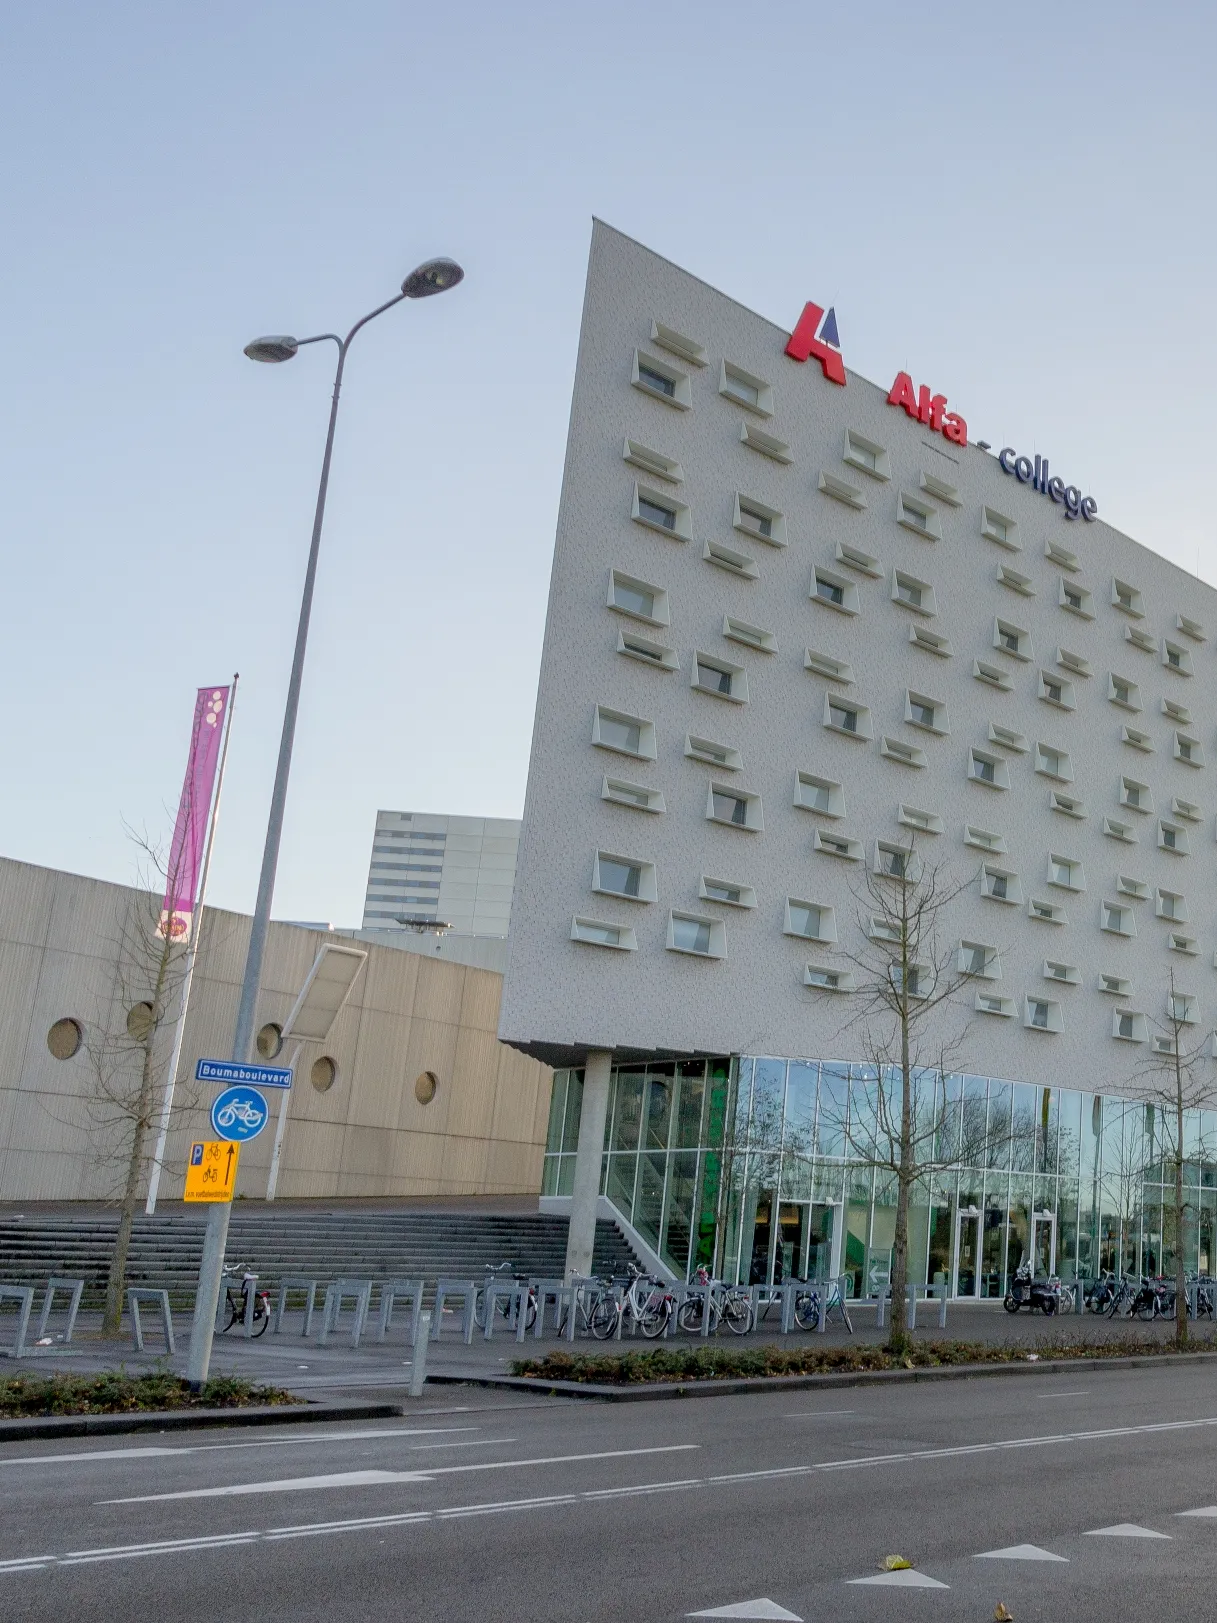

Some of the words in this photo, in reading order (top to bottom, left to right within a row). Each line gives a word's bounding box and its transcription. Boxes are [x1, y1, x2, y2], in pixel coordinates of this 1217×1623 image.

[887, 371, 968, 447] Alfa
[1000, 447, 1098, 521] college
[202, 1064, 290, 1084] Boumaboulevard
